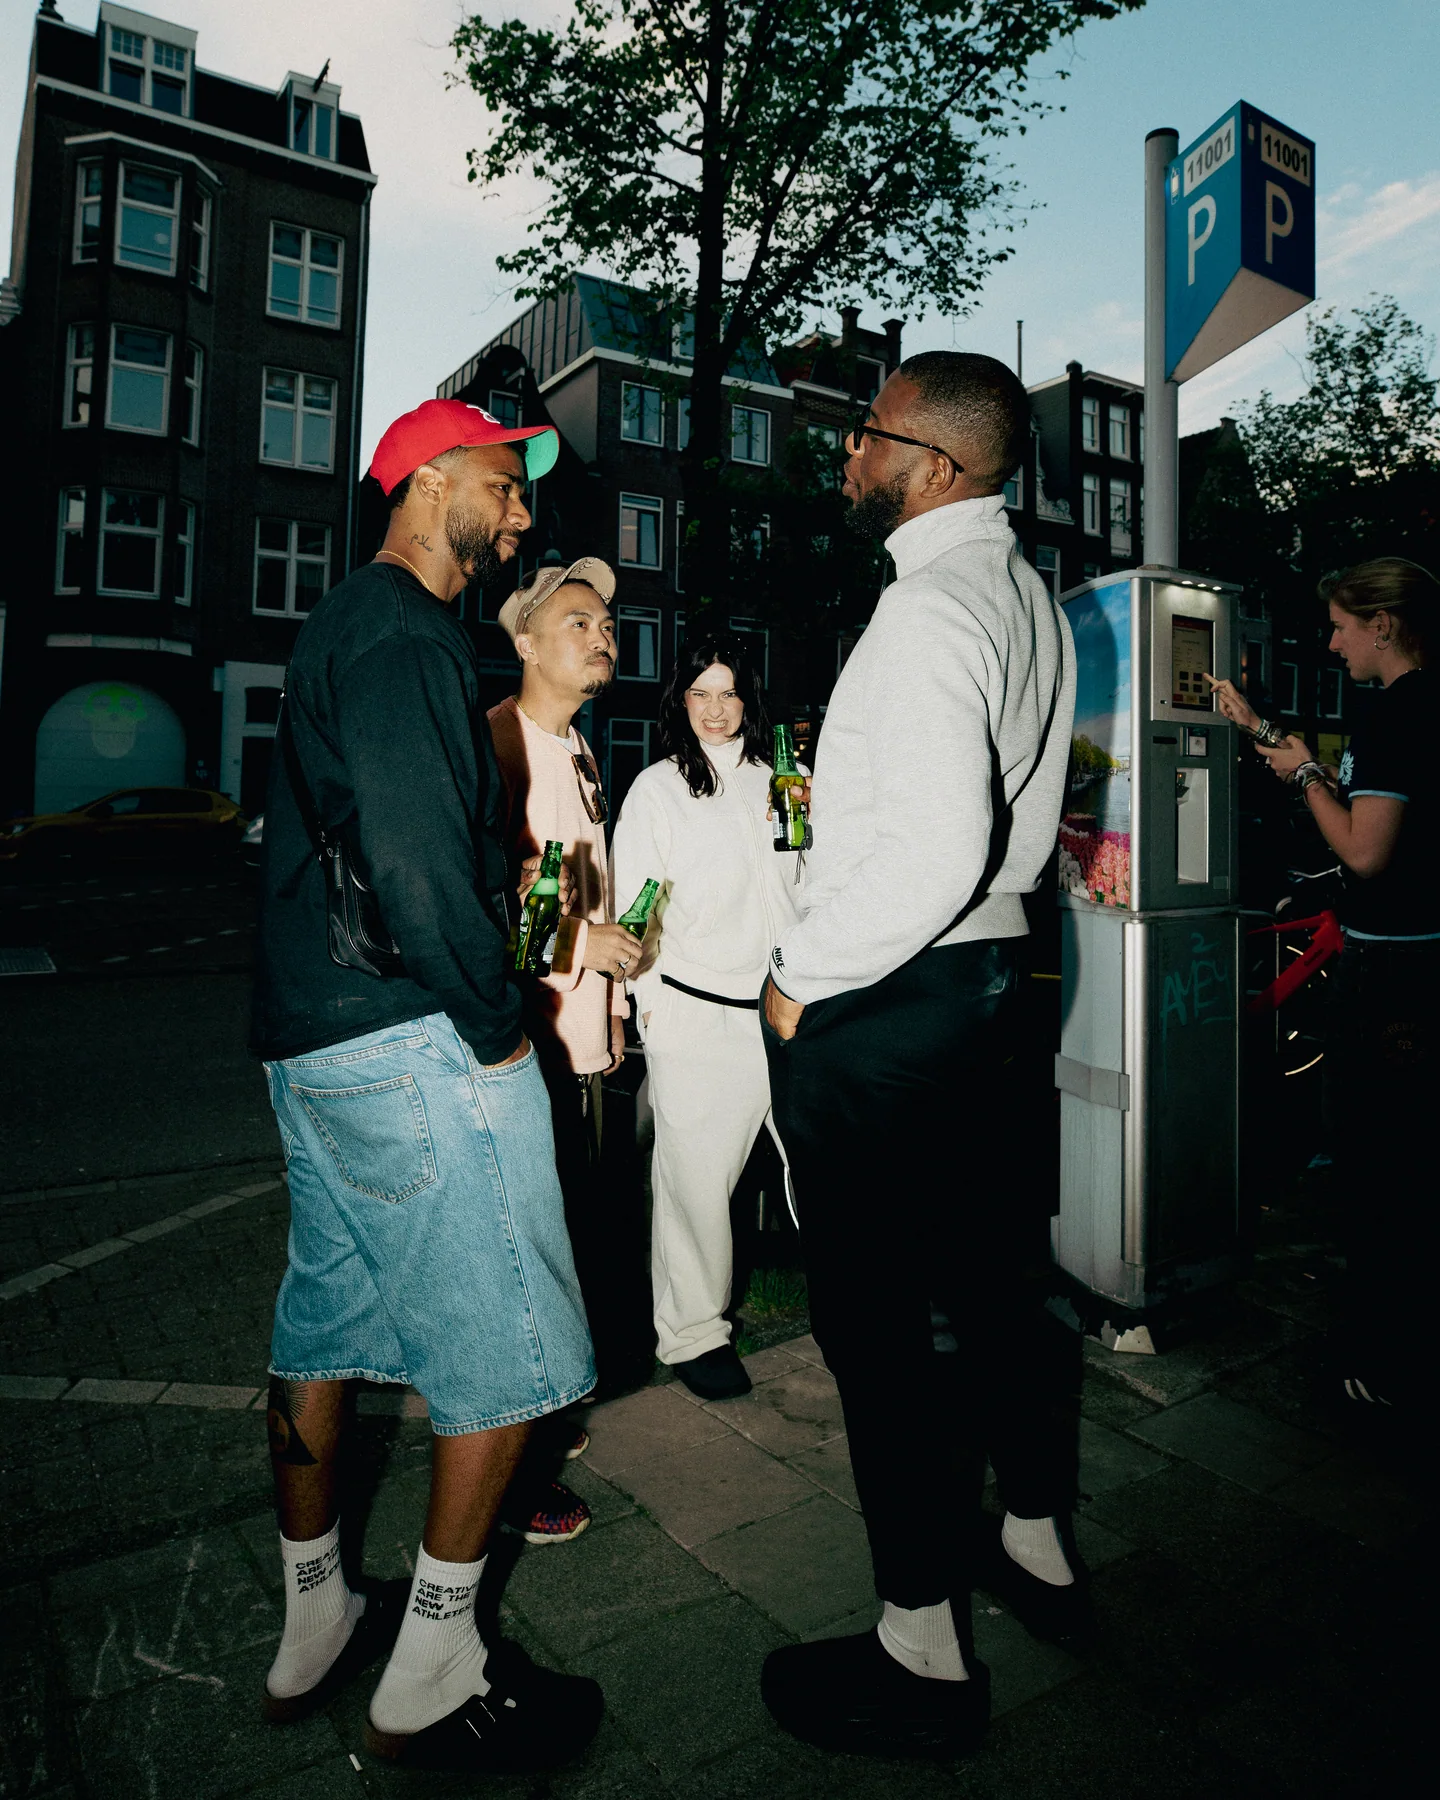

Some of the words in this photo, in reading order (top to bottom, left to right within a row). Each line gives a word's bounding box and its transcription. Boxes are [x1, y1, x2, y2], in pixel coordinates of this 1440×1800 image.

[1188, 128, 1231, 182] 11001
[1265, 134, 1308, 177] 11001
[1266, 180, 1294, 264] P
[1188, 194, 1217, 286] P
[775, 947, 786, 968] NIKE
[297, 1562, 322, 1576] ARE
[297, 1567, 326, 1585] NEW
[415, 1595, 444, 1610] NEW
[417, 1588, 442, 1601] ARE
[449, 1592, 470, 1601] THE
